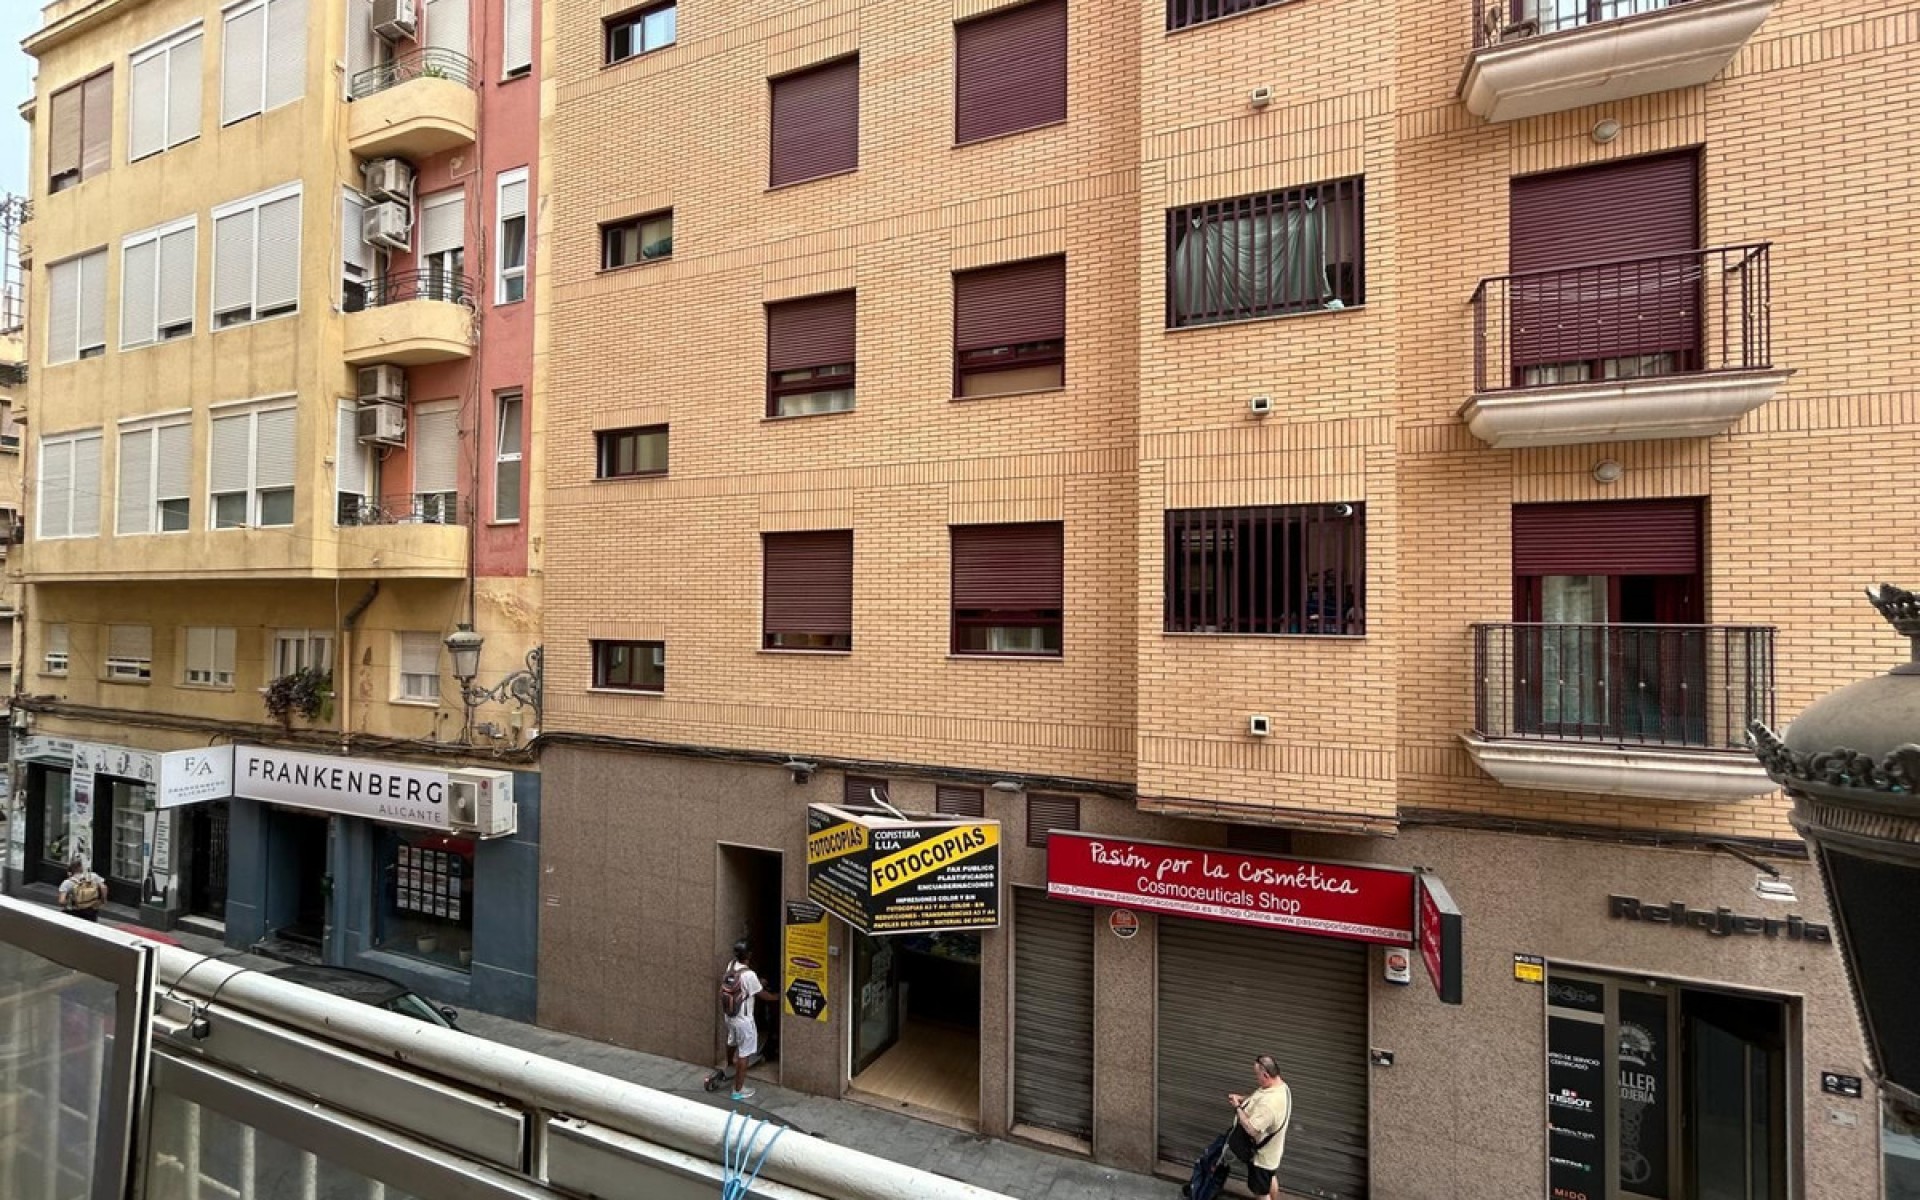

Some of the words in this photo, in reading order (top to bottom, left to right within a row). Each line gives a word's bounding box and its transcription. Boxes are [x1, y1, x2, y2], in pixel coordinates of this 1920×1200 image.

[248, 758, 444, 804] FRANKENBERG
[378, 804, 442, 823] ALICANTE
[809, 826, 863, 859] FOTOCOPIAS
[873, 827, 986, 887] FOTOCOPIAS
[1089, 842, 1151, 870] Pasión
[1156, 858, 1193, 880] por
[1202, 854, 1230, 878] la
[1238, 861, 1359, 894] Cosmética
[937, 872, 994, 881] PLASTIFICADOS
[917, 881, 994, 891] ENCUADERNACIONES
[896, 895, 937, 904] IMPRESIONES
[938, 894, 958, 902] COLOR
[1137, 876, 1254, 907] Cosmoceuticals
[1258, 892, 1301, 914] Shop
[886, 904, 924, 912] FOTOCOPIAS
[1050, 884, 1070, 895] Shop
[1071, 886, 1096, 897] Online
[1219, 908, 1242, 918] Shop
[1243, 909, 1272, 921] Online
[875, 912, 917, 920] REDUCCIONES
[921, 910, 972, 918] TRANSPARENCIAS
[873, 921, 900, 929] PAPELES
[1550, 1058, 1589, 1071] CERTIFICADO
[1572, 1055, 1601, 1066] SERVICIO
[1618, 1070, 1655, 1092] LLER
[1548, 1092, 1593, 1108] TISSOT
[1554, 1187, 1587, 1200] MIDO
